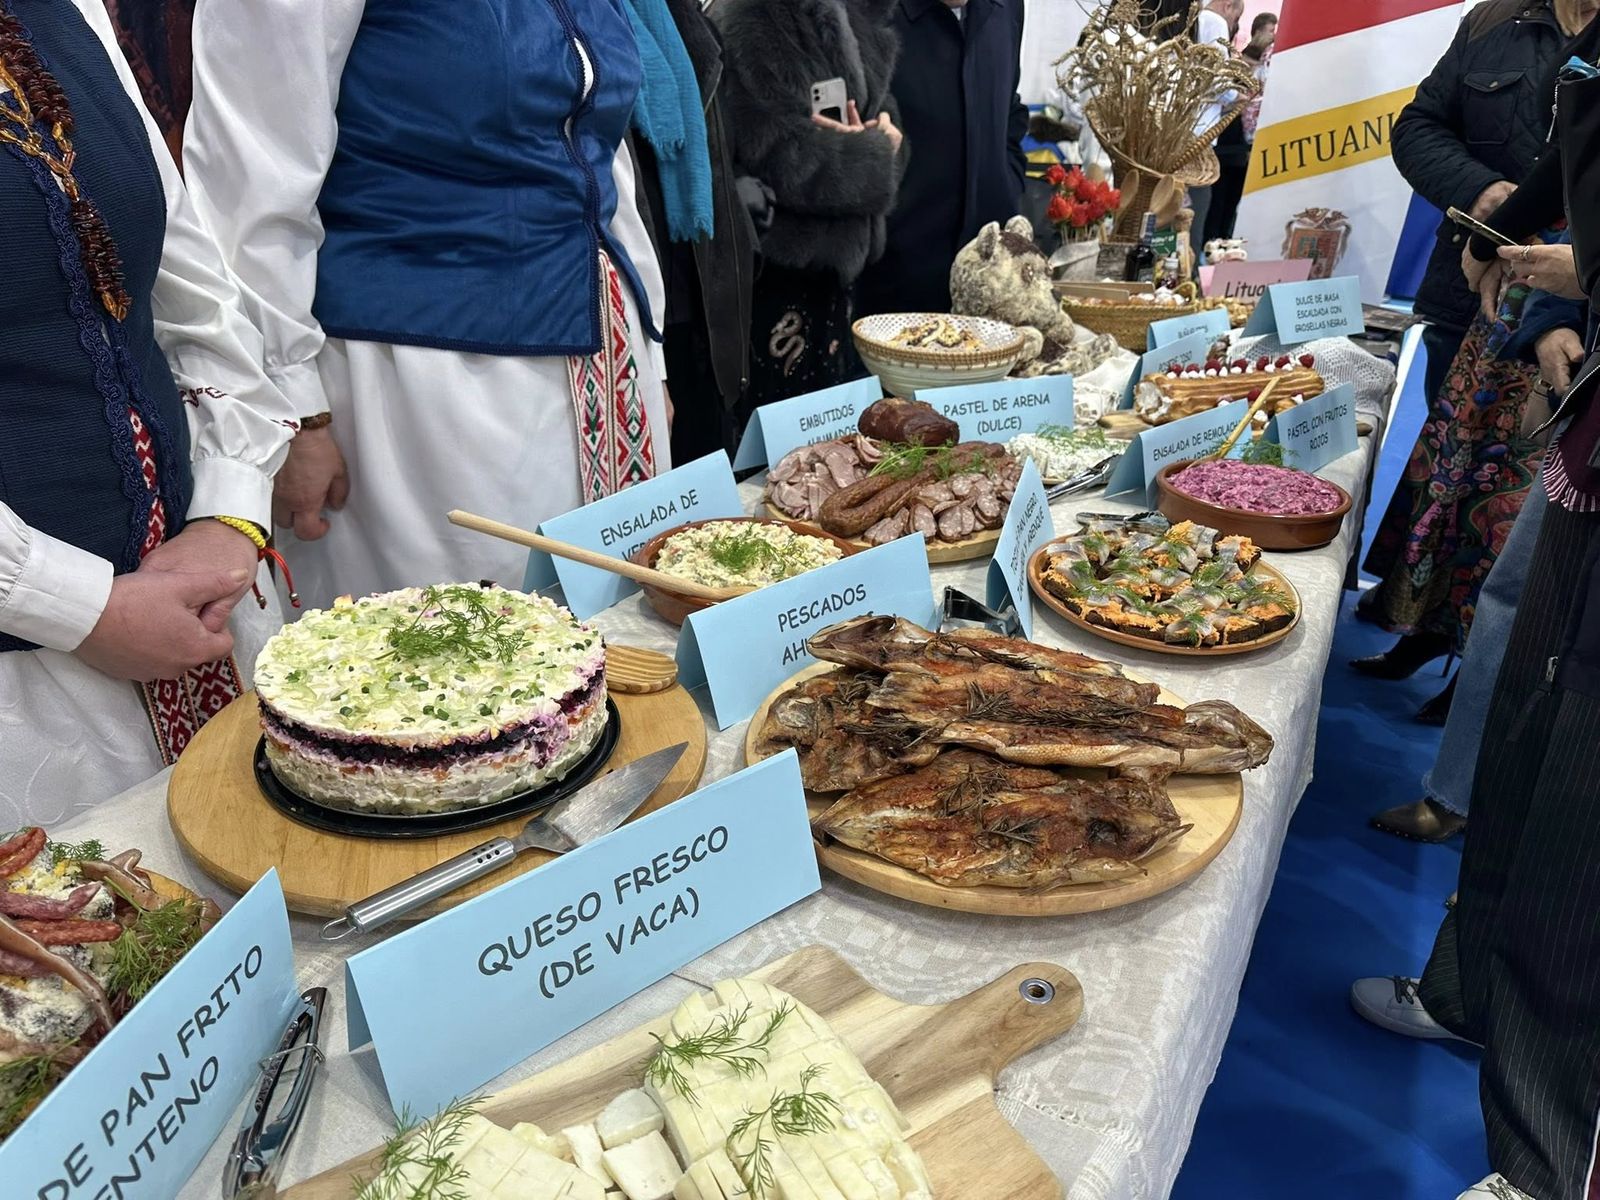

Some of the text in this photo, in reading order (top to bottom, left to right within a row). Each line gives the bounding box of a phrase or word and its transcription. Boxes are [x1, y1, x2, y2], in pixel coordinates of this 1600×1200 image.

[1261, 112, 1395, 178] LITUANI
[1225, 280, 1281, 298] Litua
[1296, 296, 1314, 305] DULCE
[1315, 295, 1323, 303] DE
[1295, 317, 1348, 333] GROSELLAS NEGRAS
[1297, 306, 1342, 319] ESCALDADA CON
[799, 404, 855, 432] EMBUTIDOS
[944, 393, 1051, 417] PASTEL DE ARENA
[1288, 404, 1348, 440] PASTEL CON FRUTOS
[977, 416, 1022, 435] (DULCE)
[1153, 439, 1189, 461] ENSALADA
[1192, 433, 1202, 446] DE
[1204, 420, 1241, 441] REMOLACH
[1310, 432, 1329, 450] ROJOS
[600, 500, 677, 546] ENSALADA
[680, 489, 699, 509] DE
[777, 584, 866, 632] PESCADOS
[477, 825, 730, 976] QUESO FRESCO
[539, 887, 700, 999] (DE VACA)
[100, 1053, 171, 1147] PAN
[176, 944, 263, 1059] FRITO
[94, 1055, 219, 1200] NTENO
